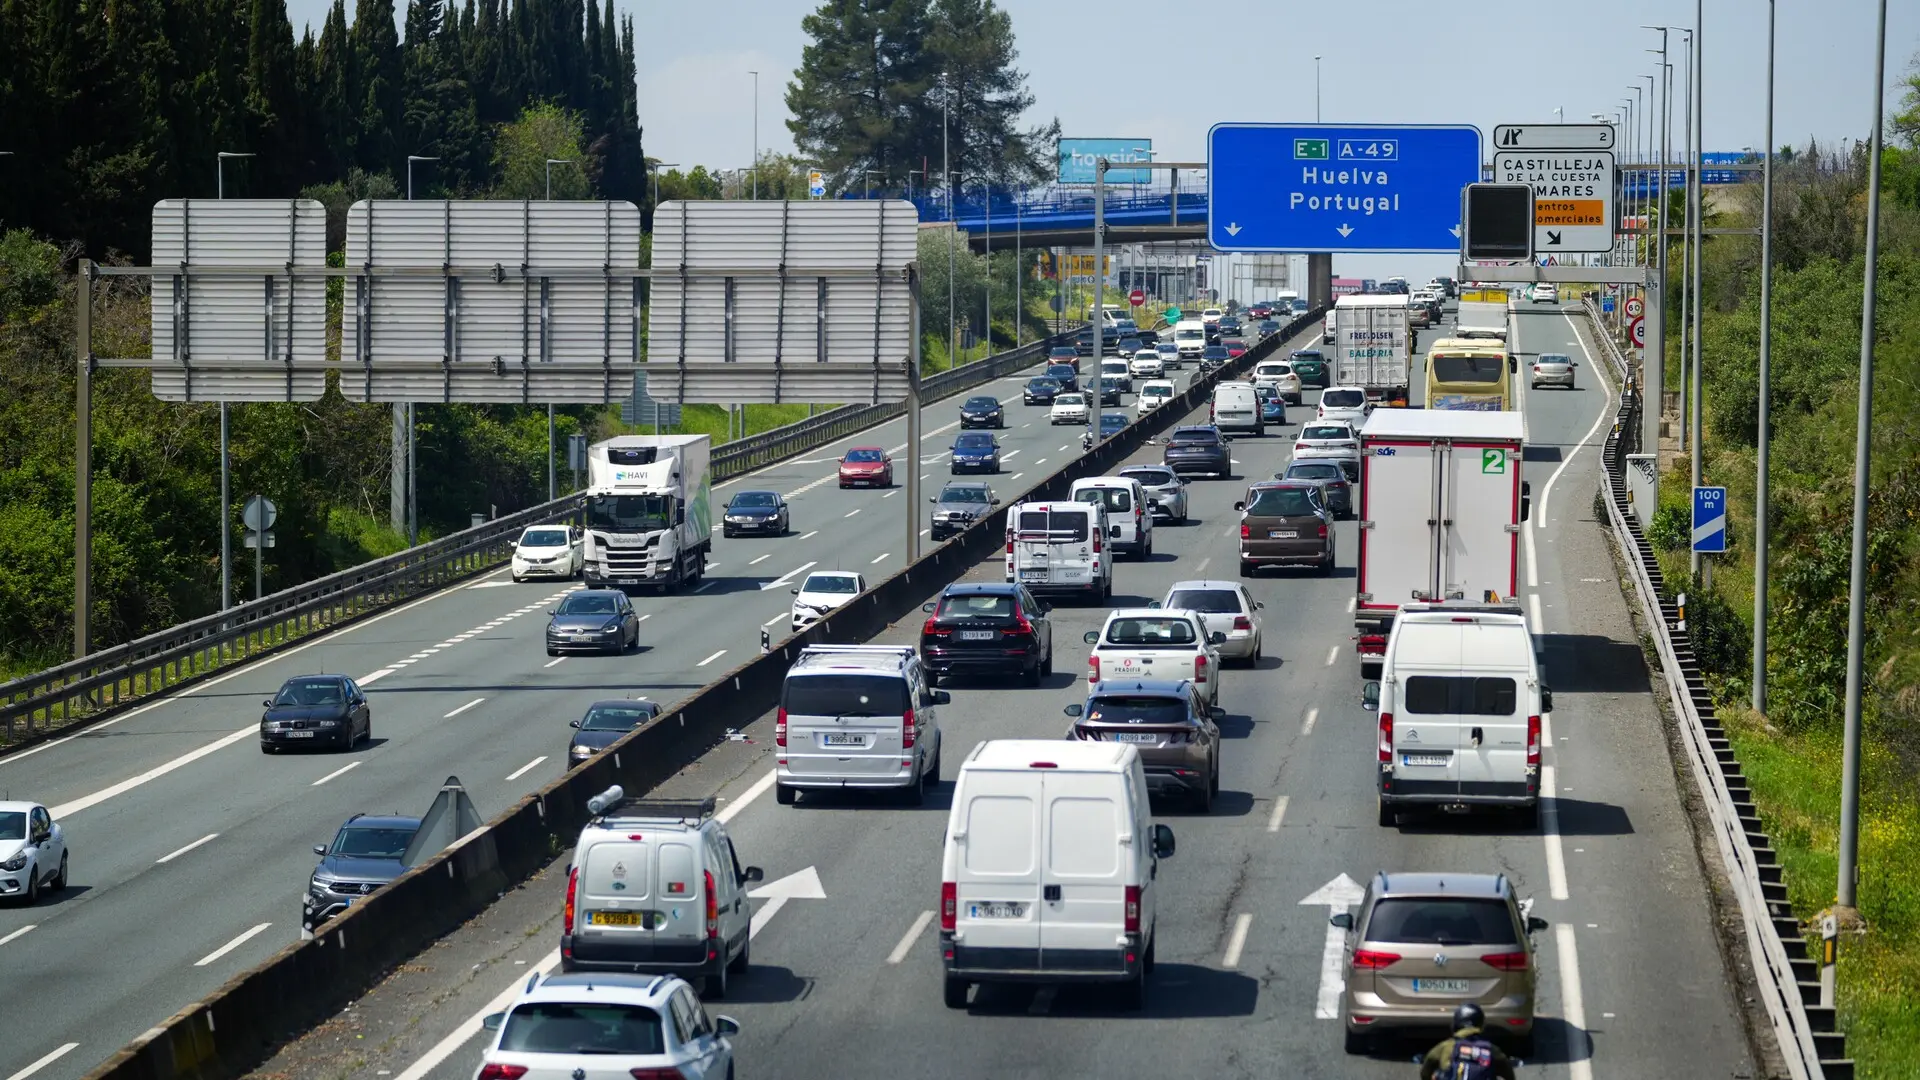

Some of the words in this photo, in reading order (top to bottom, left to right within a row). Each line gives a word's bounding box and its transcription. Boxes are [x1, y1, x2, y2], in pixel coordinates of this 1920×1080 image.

[1599, 132, 1607, 141] 2
[1297, 142, 1326, 157] E-1
[1340, 142, 1394, 157] A-49
[1503, 159, 1605, 170] CASTILLEJA
[1303, 166, 1388, 185] Huelva
[1507, 173, 1523, 182] DE
[1529, 173, 1545, 182] LA
[1551, 172, 1601, 182] CUESTA
[1536, 185, 1594, 196] MARES
[1290, 192, 1399, 215] Portugal
[1537, 203, 1575, 211] entros
[1536, 214, 1601, 223] omerciales
[1628, 304, 1641, 312] 60
[1637, 326, 1645, 337] 8
[1484, 449, 1503, 473] 2
[627, 471, 648, 479] HAVI
[1699, 490, 1720, 500] 100
[1704, 501, 1714, 509] m
